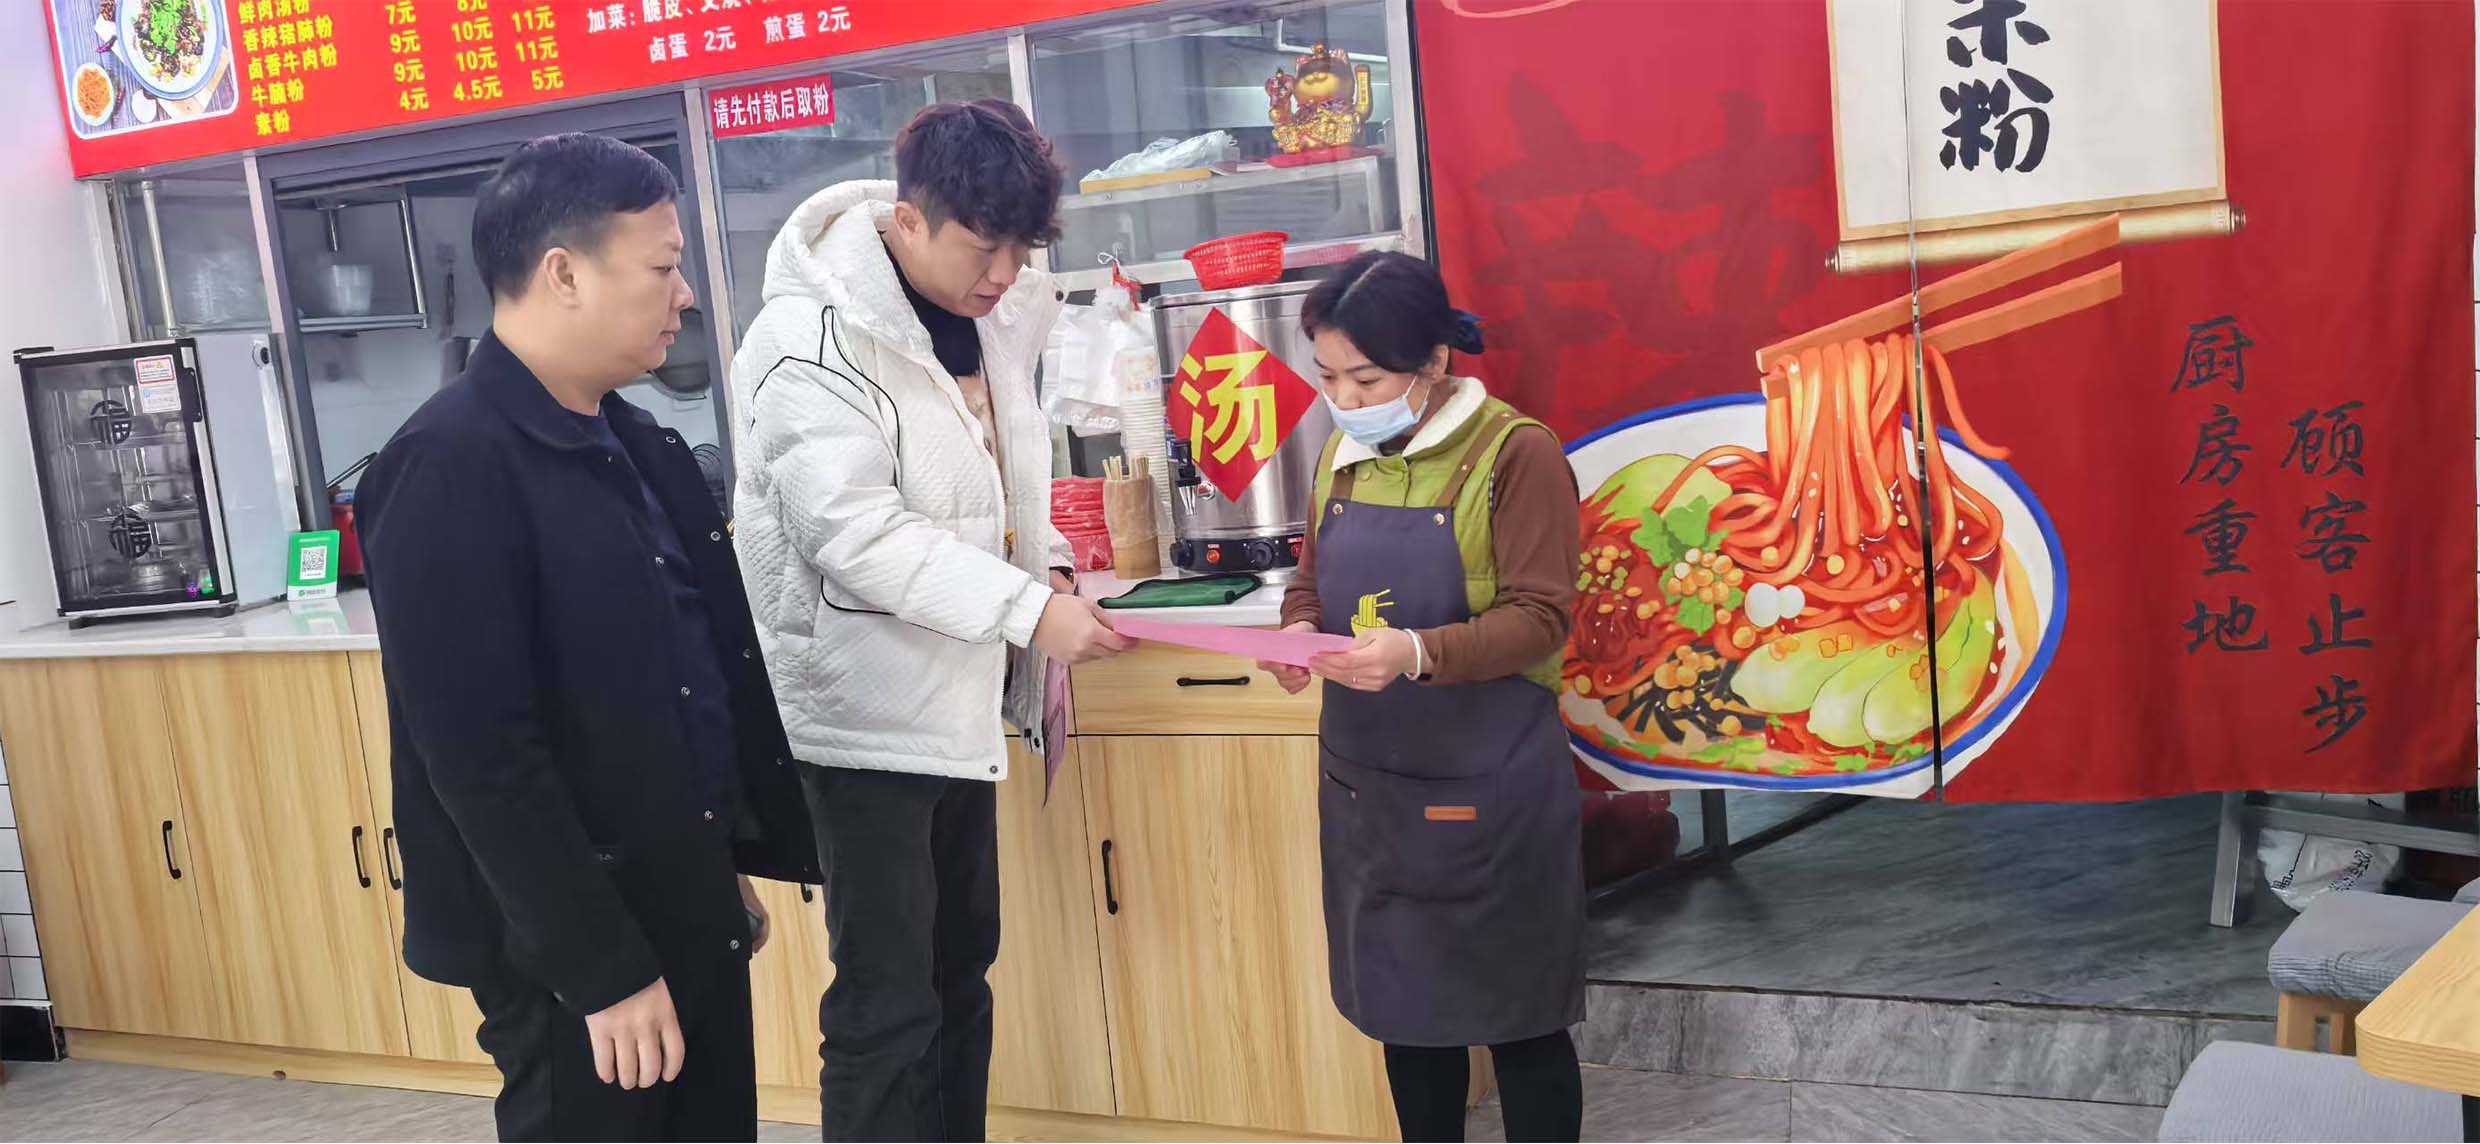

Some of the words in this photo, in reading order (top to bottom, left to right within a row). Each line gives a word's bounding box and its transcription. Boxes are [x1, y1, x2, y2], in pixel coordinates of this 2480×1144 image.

[385, 0, 416, 24] 7元
[649, 33, 688, 62] 卤蛋
[704, 26, 736, 51] 2元
[764, 13, 806, 43] 煎蛋
[818, 6, 851, 32] 2元
[248, 43, 336, 80] 卤香牛肉粉
[390, 30, 421, 53] 9元
[452, 16, 493, 42] 10元
[512, 6, 554, 32] 11元
[394, 58, 425, 82] 9元
[456, 46, 497, 71] 10元
[516, 36, 558, 61] 11元
[400, 87, 429, 110] 4元
[454, 75, 503, 101] 4.5元
[532, 66, 563, 90] 5元
[714, 84, 828, 128] 请先付款后取粉
[1180, 351, 1276, 463] 汤
[2171, 316, 2269, 654] 厨房重地
[2281, 401, 2374, 753] 顾客止步
